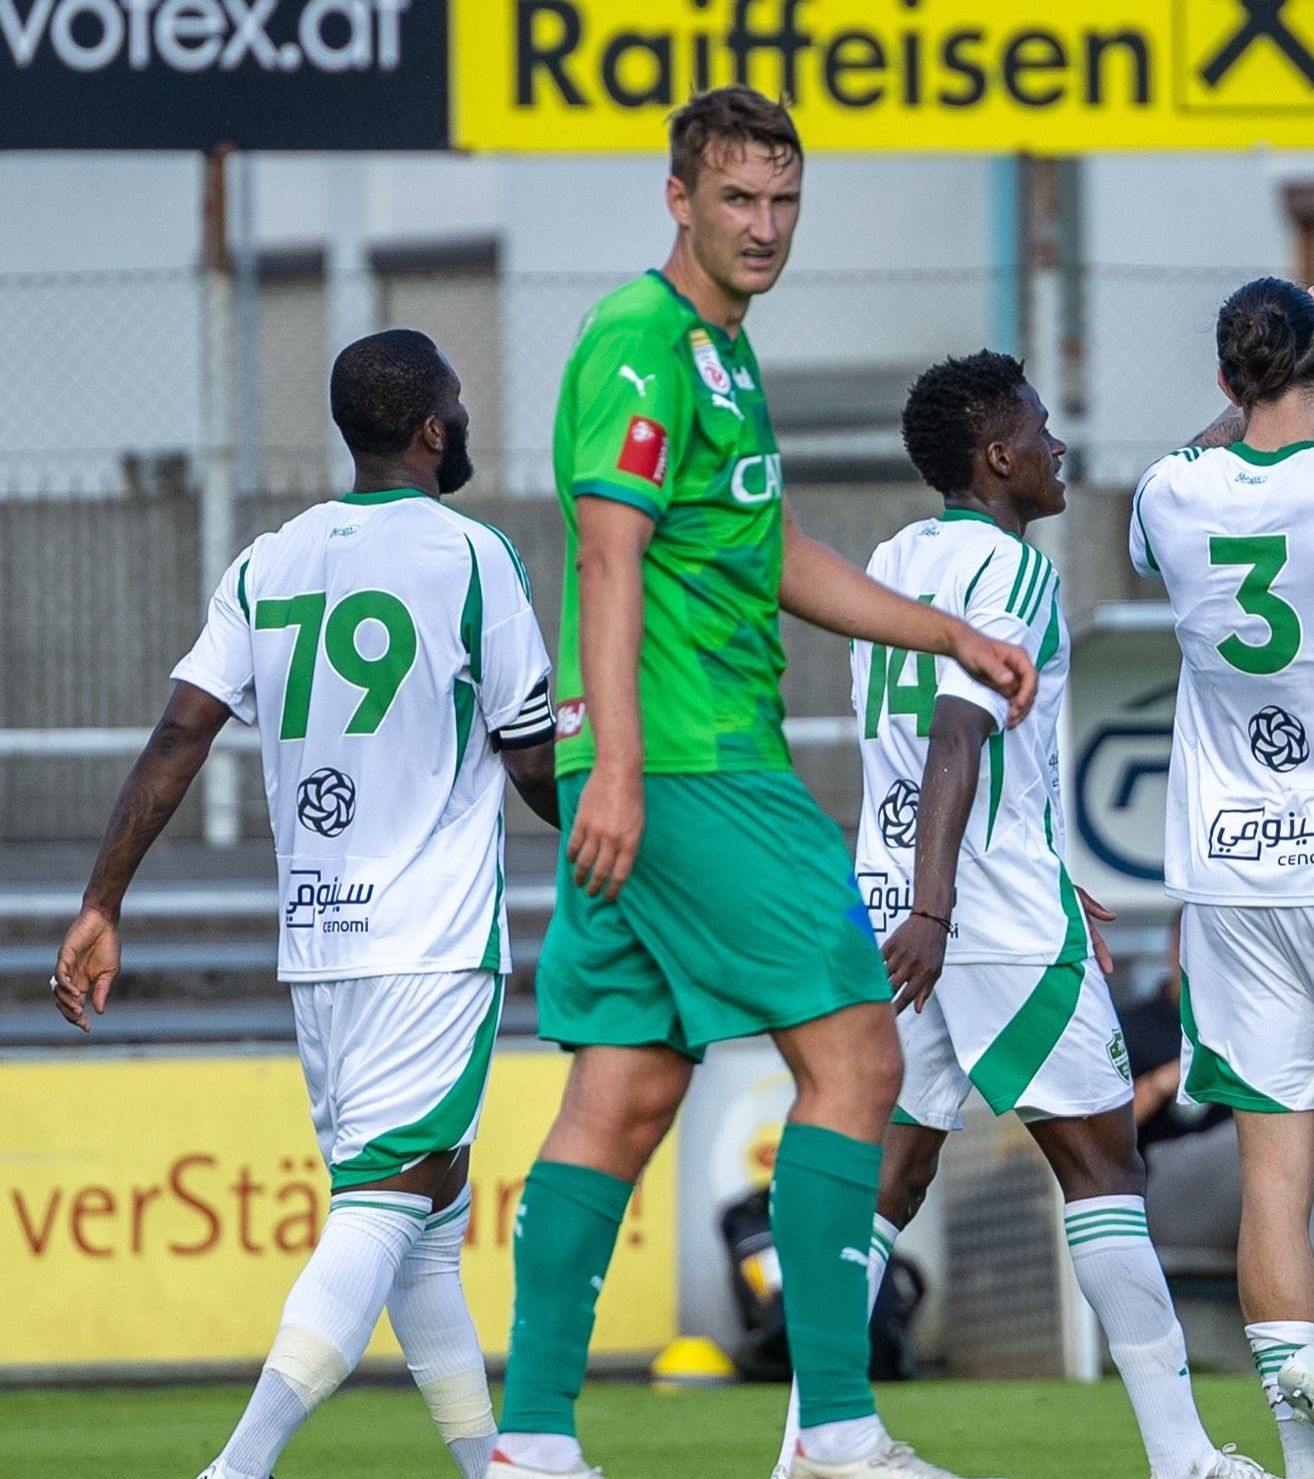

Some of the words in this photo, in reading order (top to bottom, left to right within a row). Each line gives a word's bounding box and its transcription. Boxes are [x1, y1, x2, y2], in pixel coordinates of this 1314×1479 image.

[512, 0, 1152, 109] Raiffeisen
[255, 588, 419, 742] 79
[864, 593, 938, 740] 14
[1208, 533, 1302, 675] 3
